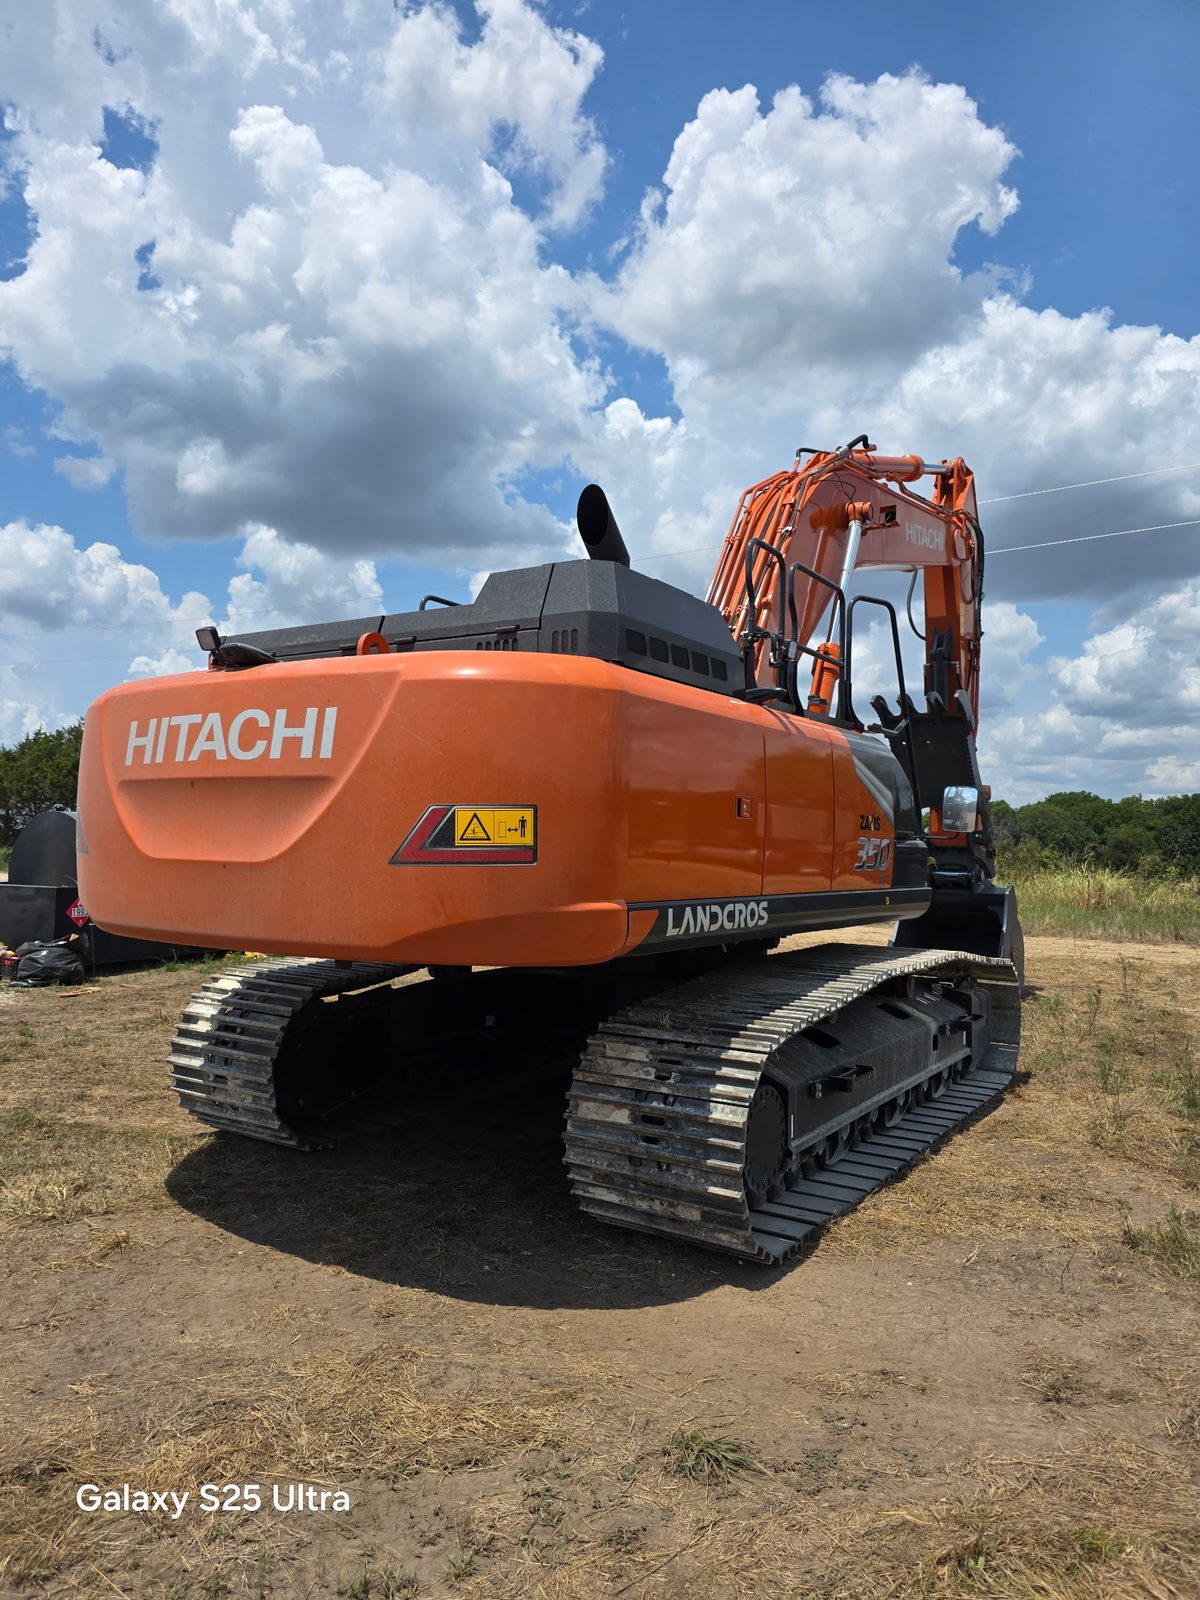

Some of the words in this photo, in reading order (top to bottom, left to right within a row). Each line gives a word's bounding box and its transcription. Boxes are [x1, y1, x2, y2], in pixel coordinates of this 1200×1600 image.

[905, 521, 944, 552] HITACHI
[124, 706, 338, 766] HITACHI
[853, 837, 890, 872] 350
[665, 901, 769, 937] LANDCROS
